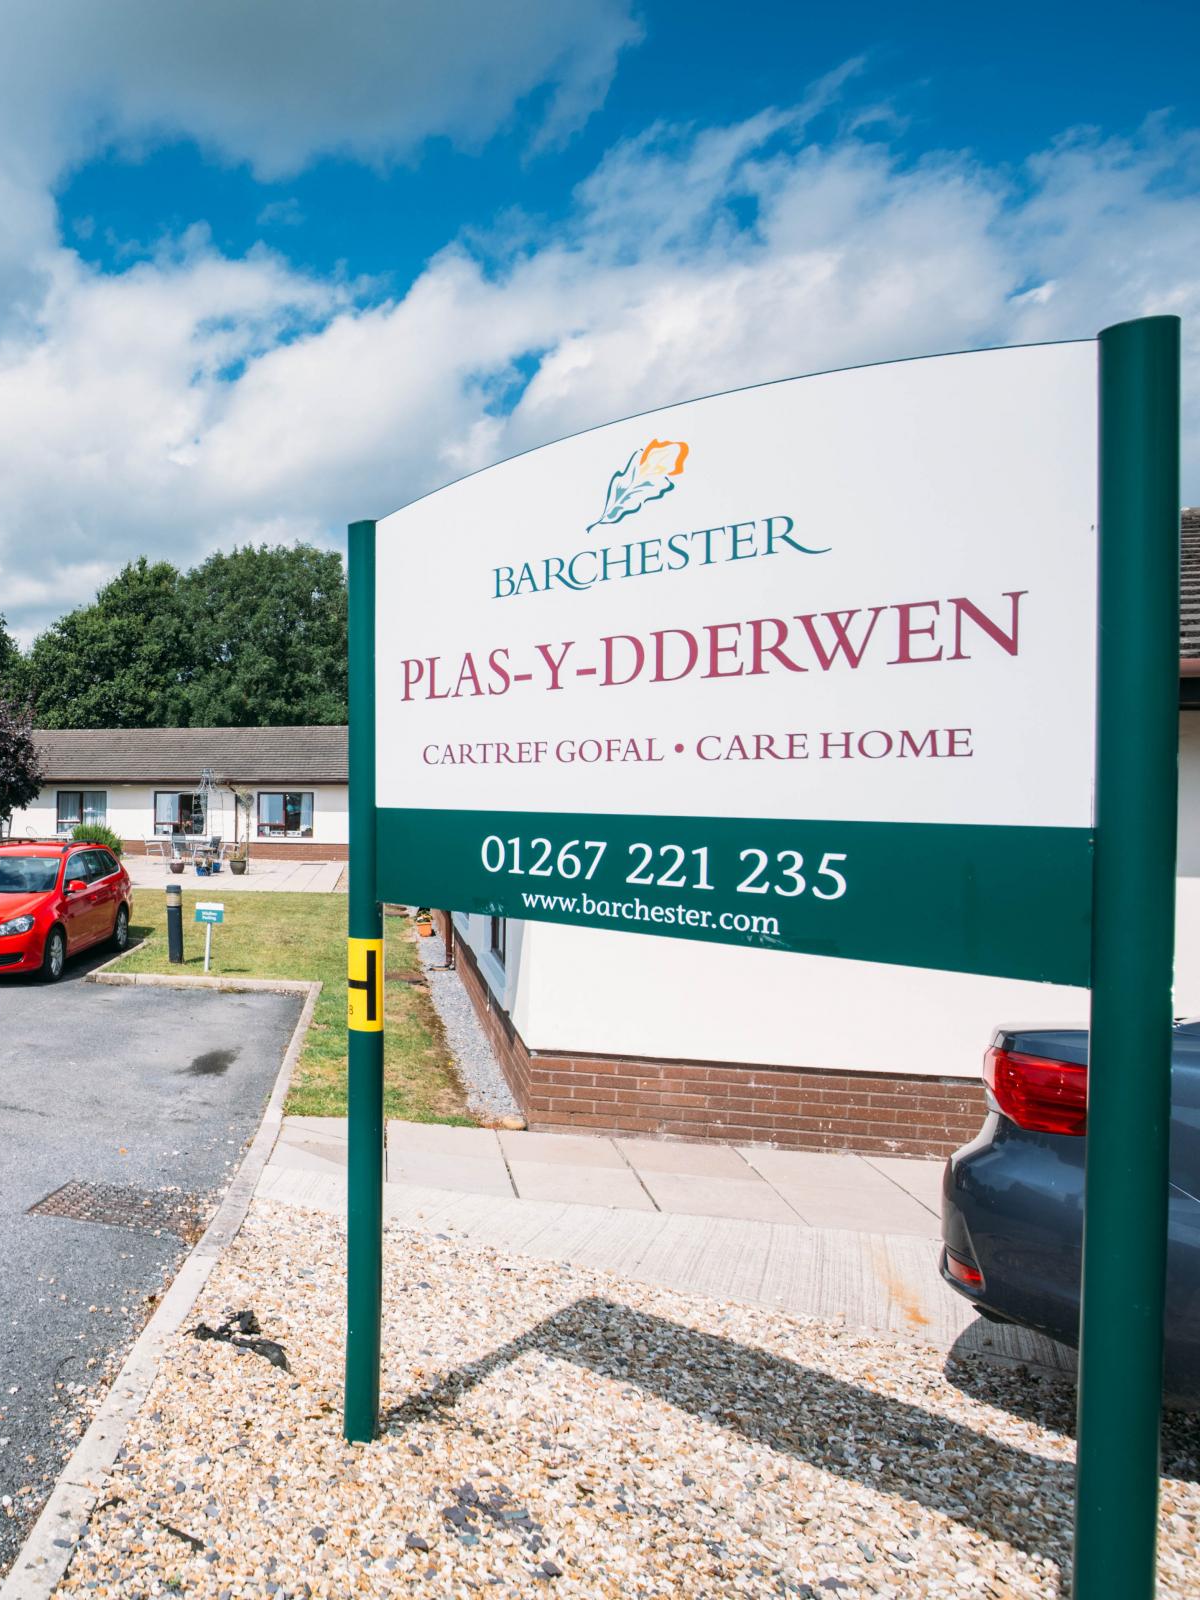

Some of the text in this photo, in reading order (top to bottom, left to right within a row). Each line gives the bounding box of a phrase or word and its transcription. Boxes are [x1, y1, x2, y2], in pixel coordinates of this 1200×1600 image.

[492, 515, 833, 599] BARCHESTER
[400, 589, 1029, 702] PLAS-Y-DDERWEN
[422, 728, 974, 765] CARTREF GOFAL CARE HOME
[481, 835, 848, 900] 01267 221 235
[521, 891, 781, 936] www.barchester.com
